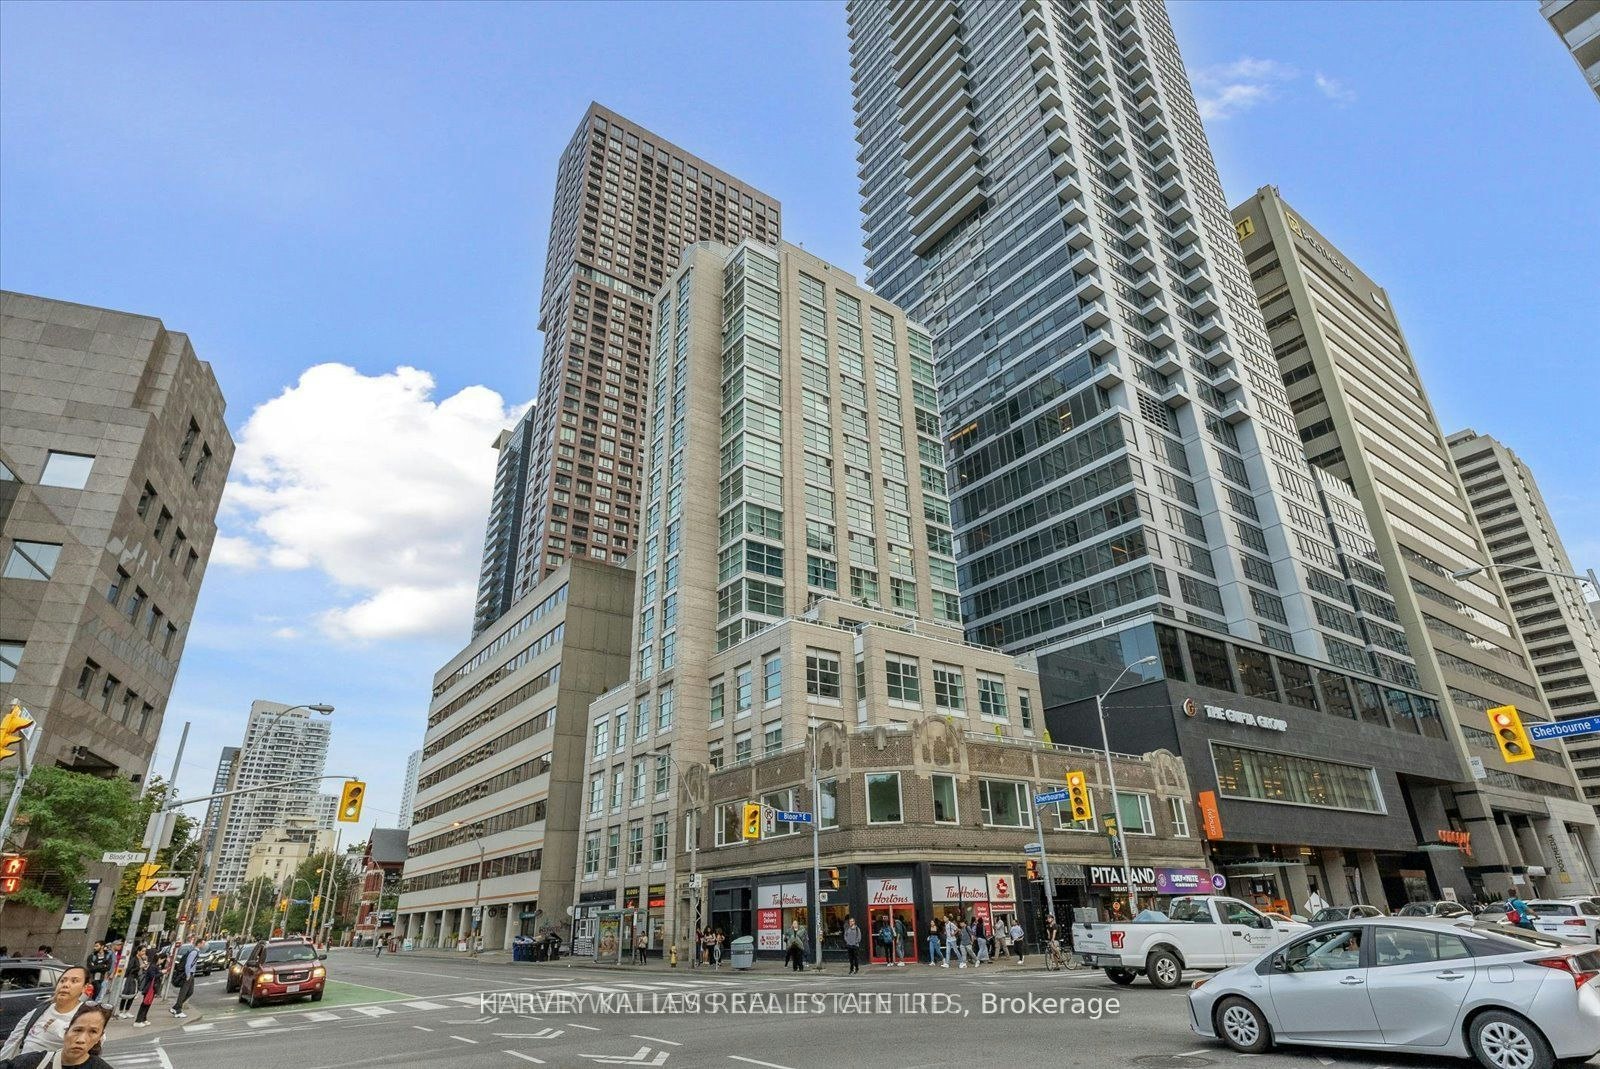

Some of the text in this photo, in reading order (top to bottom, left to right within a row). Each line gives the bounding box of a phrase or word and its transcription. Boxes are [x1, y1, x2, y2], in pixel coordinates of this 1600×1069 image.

[1204, 705, 1226, 720] THE
[1533, 721, 1591, 738] Sherbourne
[1036, 791, 1066, 803] Sherbourne
[1548, 834, 1566, 873] POSTMEDIA
[1090, 866, 1156, 884] PITA LAND
[6, 879, 16, 892] 4
[880, 879, 898, 891] Tim
[945, 885, 989, 899] Tim Hortons
[873, 892, 909, 904] Hortons
